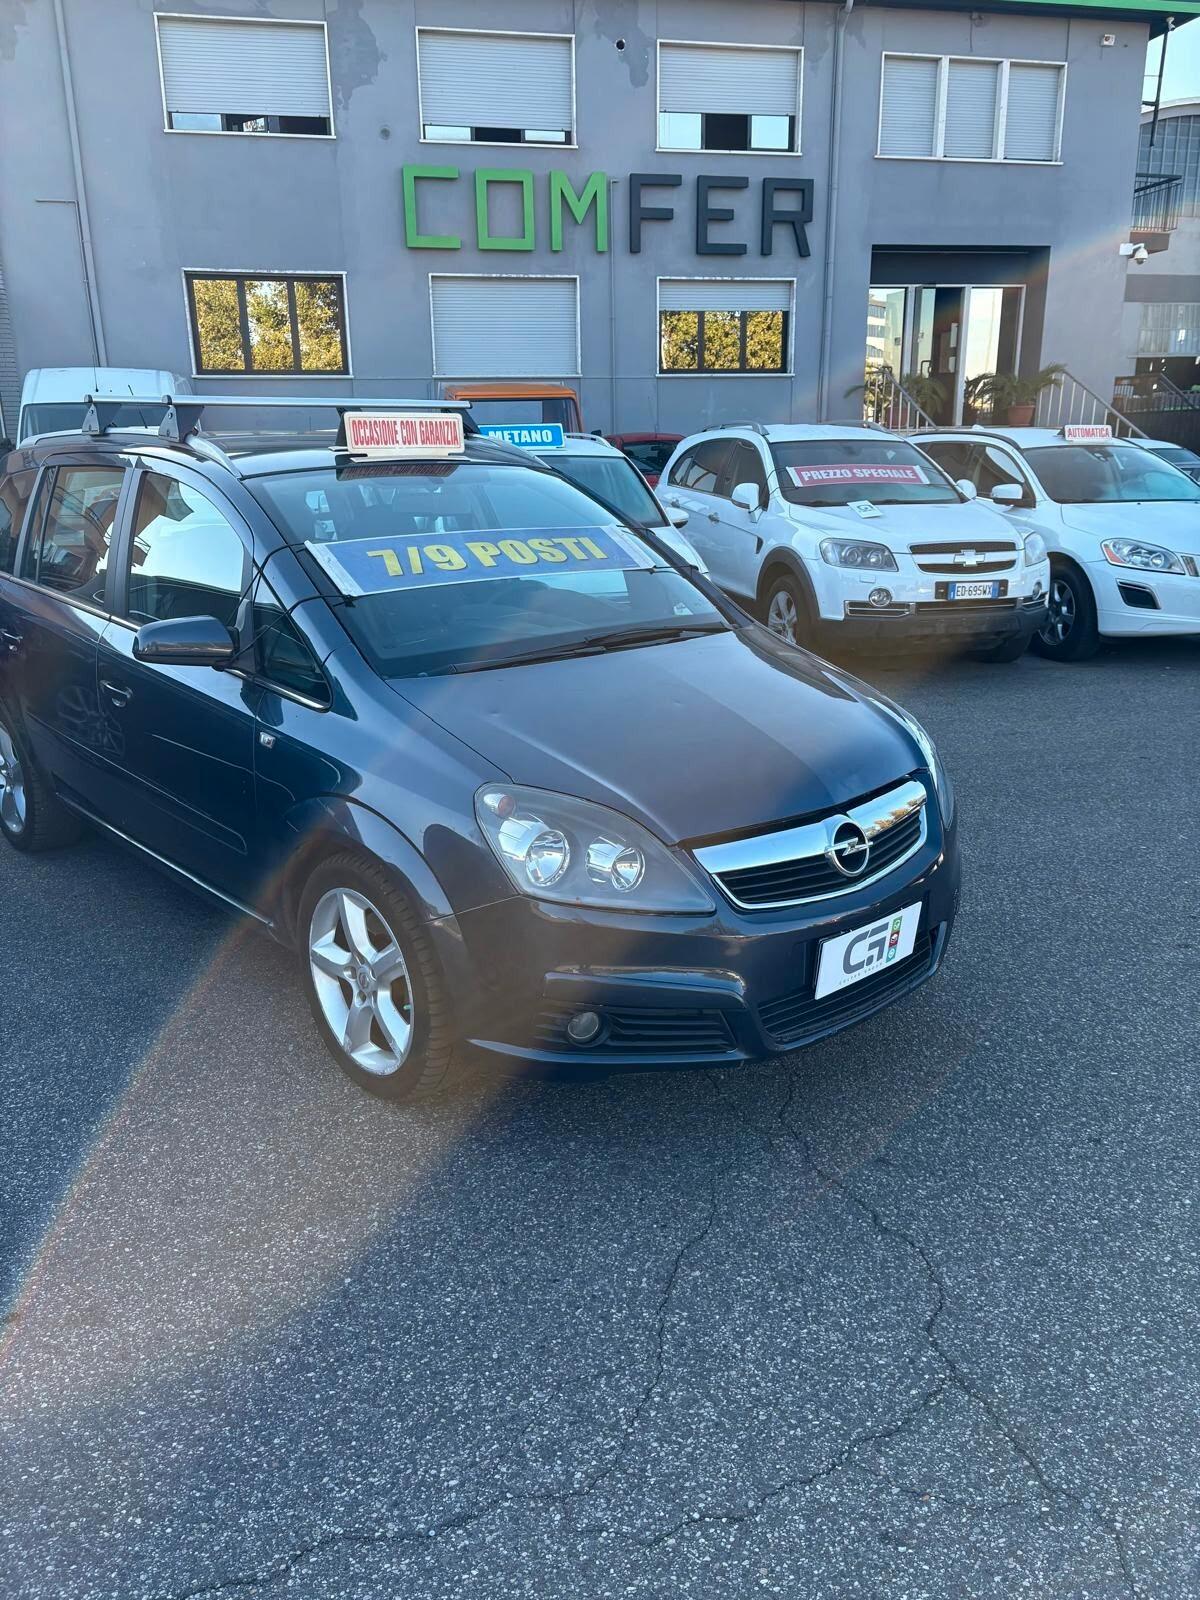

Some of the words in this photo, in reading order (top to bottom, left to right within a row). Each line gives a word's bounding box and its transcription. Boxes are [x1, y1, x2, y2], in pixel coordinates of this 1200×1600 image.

[402, 165, 814, 258] COMFER
[351, 419, 399, 446] OCCASIONE
[400, 419, 418, 446] CON
[419, 419, 459, 446] GARANZIA
[488, 429, 553, 443] METANO
[1067, 427, 1111, 438] AUTOMATICA
[800, 468, 851, 481] PREZZO
[853, 467, 917, 480] SPECIALE
[366, 543, 468, 577] 7/9
[465, 536, 609, 568] POSTI
